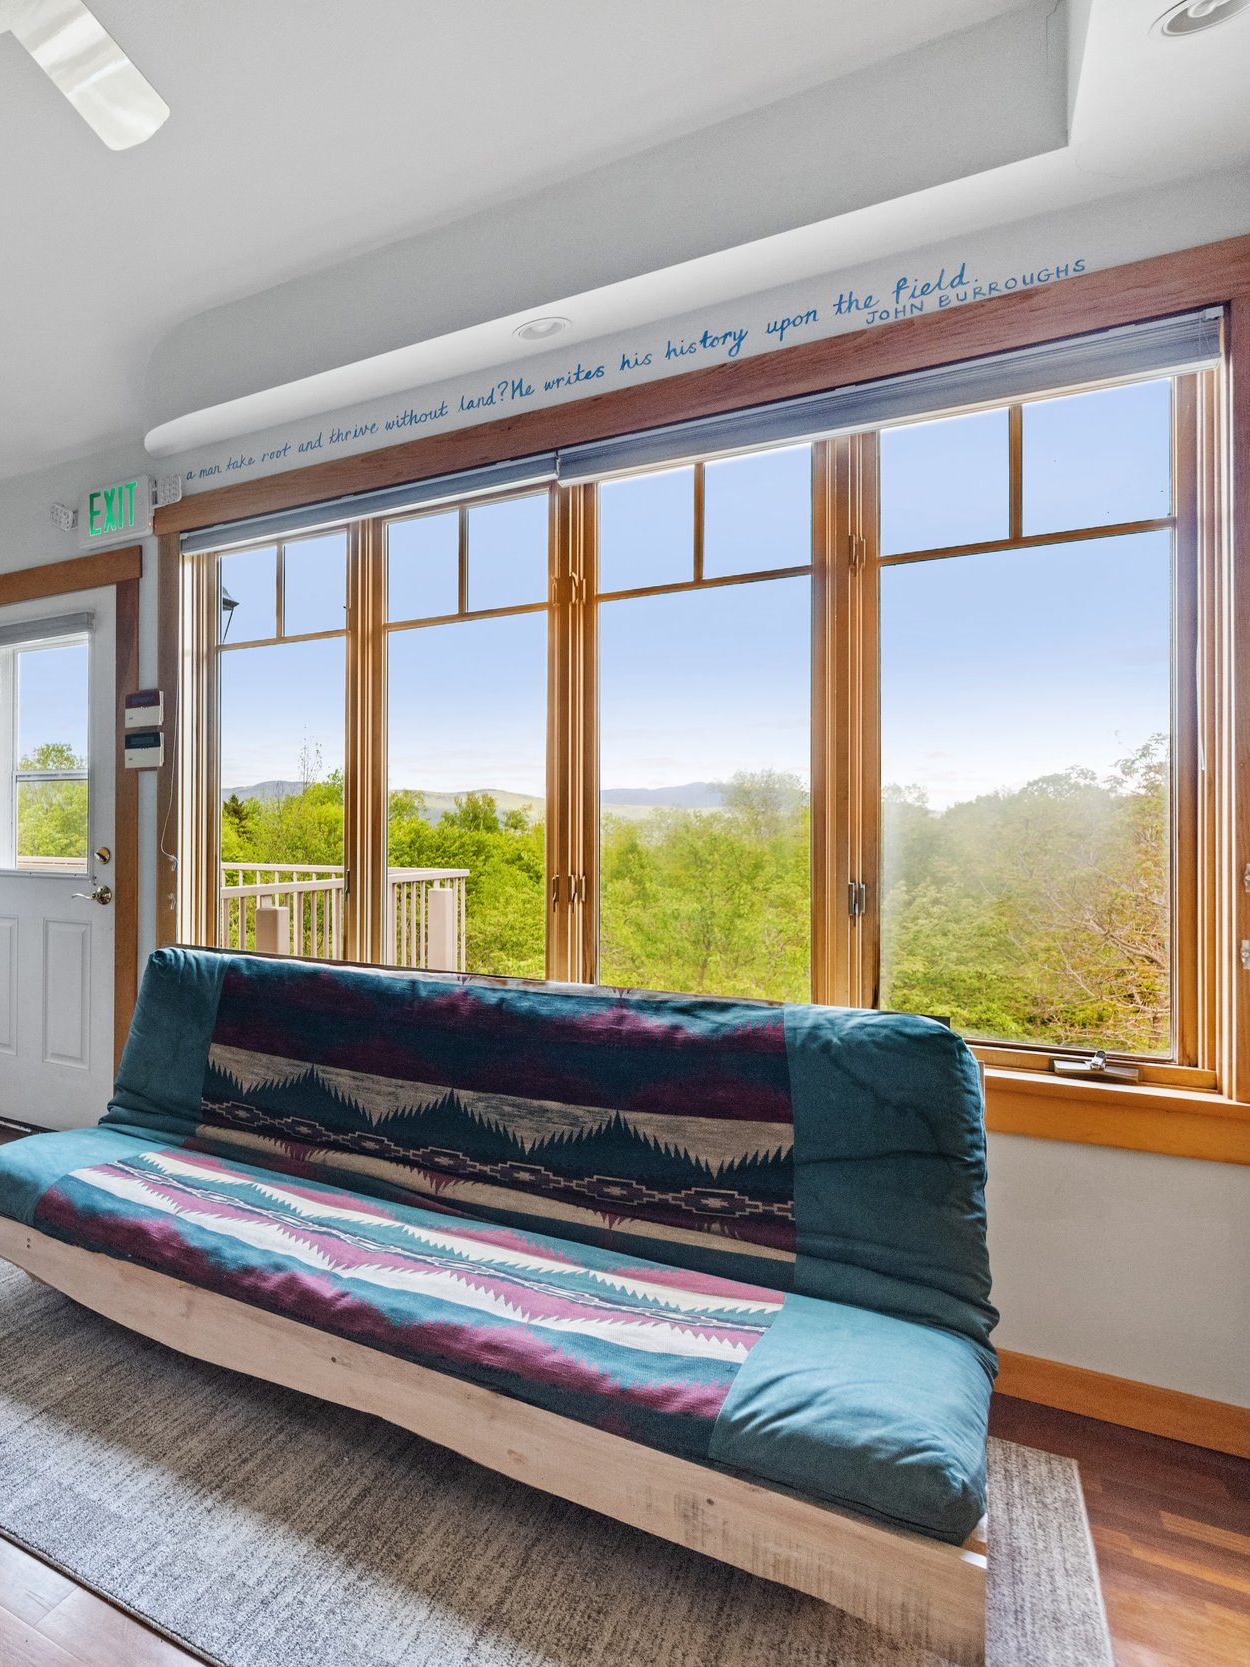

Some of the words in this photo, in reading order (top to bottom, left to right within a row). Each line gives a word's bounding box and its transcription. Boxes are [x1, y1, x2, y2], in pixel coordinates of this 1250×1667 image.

[866, 300, 924, 325] JOHN
[939, 258, 1087, 307] BURROUGHS
[186, 470, 196, 482] a
[198, 464, 222, 478] man
[226, 453, 255, 473] take
[261, 443, 291, 464] root
[297, 432, 323, 454] and
[328, 421, 379, 446] thrive
[385, 399, 448, 432] without
[544, 364, 605, 391] writes
[619, 352, 652, 371] his
[665, 328, 749, 357] history
[765, 308, 819, 341] upon
[833, 291, 880, 315] the
[892, 262, 979, 304] field.
[89, 481, 138, 537] EXIT
